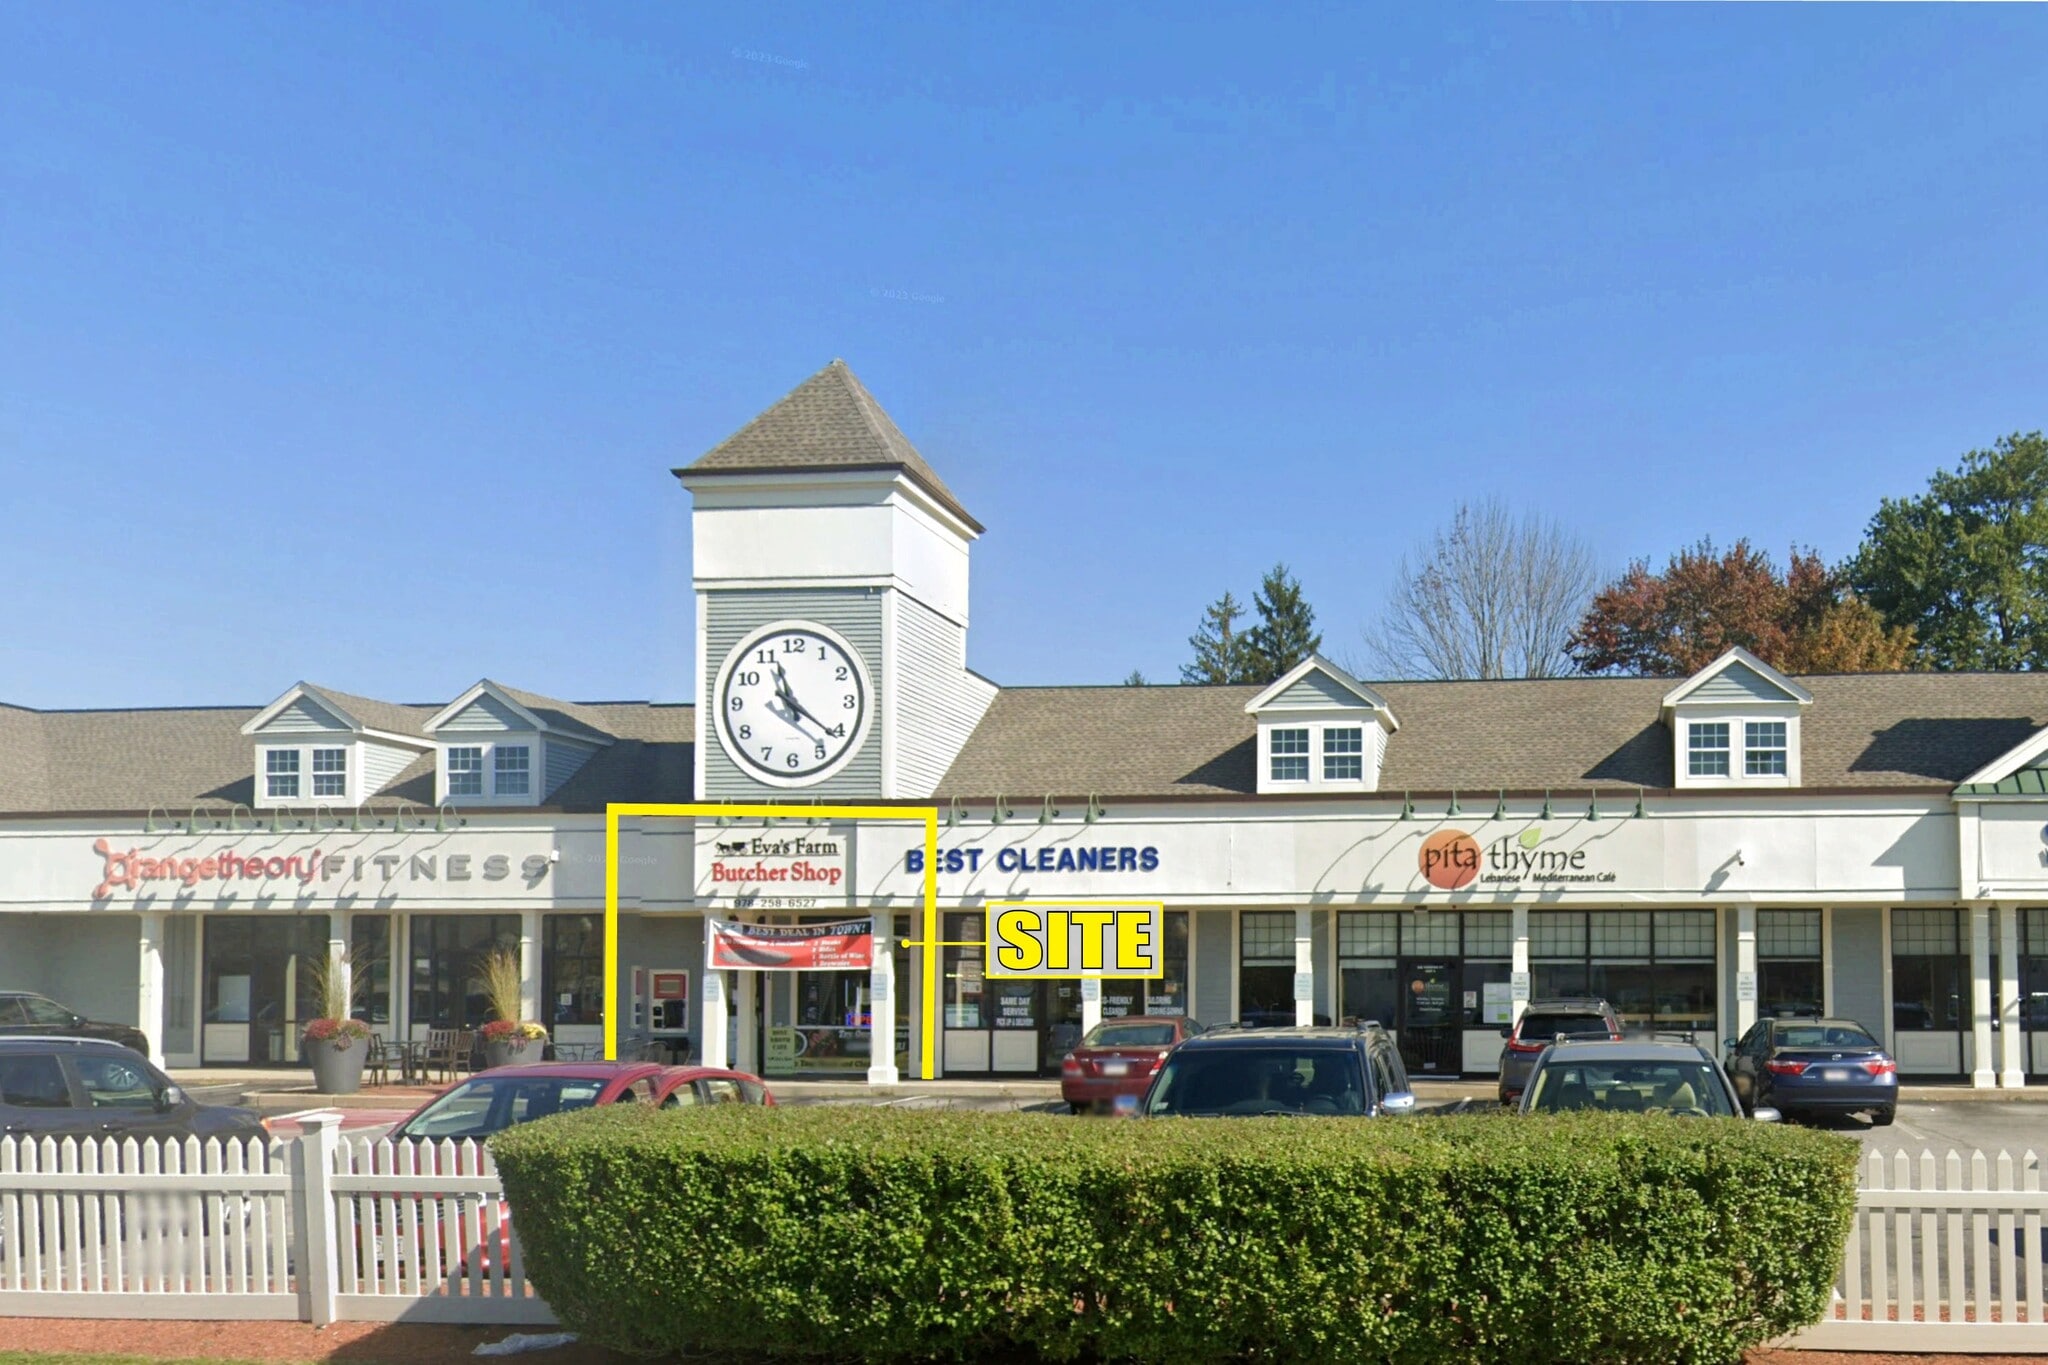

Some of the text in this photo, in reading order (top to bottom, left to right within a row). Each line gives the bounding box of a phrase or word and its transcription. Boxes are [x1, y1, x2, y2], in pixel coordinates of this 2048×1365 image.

[783, 638, 805, 653] 12
[757, 650, 776, 663] 11
[818, 646, 827, 660] 1
[738, 671, 760, 686] 10
[835, 666, 848, 681] 2
[731, 697, 743, 711] 9
[843, 695, 855, 709] 3
[739, 725, 752, 739] 8
[833, 723, 846, 737] 4
[761, 746, 773, 761] 7
[815, 745, 826, 759] 5
[786, 753, 799, 768] 6
[751, 837, 838, 855] Eva's Farm
[997, 846, 1160, 873] CLEANERS
[1424, 837, 1587, 880] pita thyme
[321, 854, 549, 882] FITNESS
[711, 861, 842, 885] Butcher Shop
[1480, 873, 1521, 883] Lebanese
[1532, 872, 1595, 883] Mediterranean
[748, 923, 866, 937] BEST DEAL IN TOWN!
[1000, 997, 1031, 1006] SAME DAY
[1003, 1007, 1028, 1016] SERVICE
